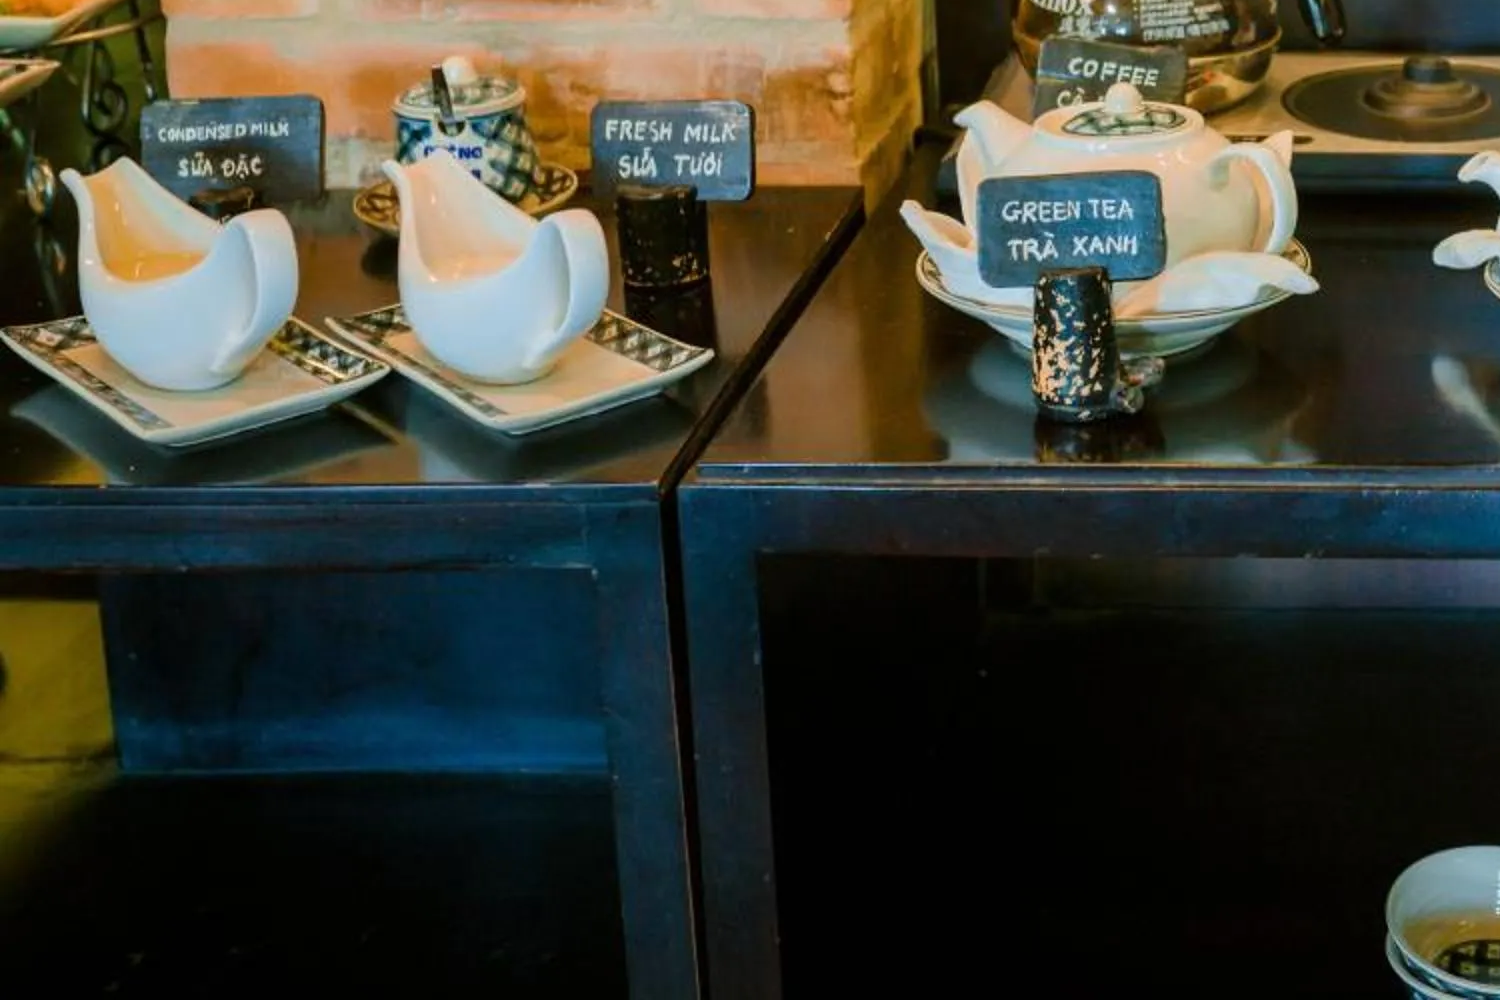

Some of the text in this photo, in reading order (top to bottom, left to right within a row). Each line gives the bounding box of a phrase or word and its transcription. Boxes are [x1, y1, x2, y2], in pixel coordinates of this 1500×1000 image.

[1067, 56, 1160, 87] COFFEE
[158, 117, 290, 144] CONDENSED MILK
[604, 119, 737, 144] FRESH MILK
[1001, 198, 1135, 224] GREEN TEA
[1007, 231, 1139, 262] TRÀ XANH
